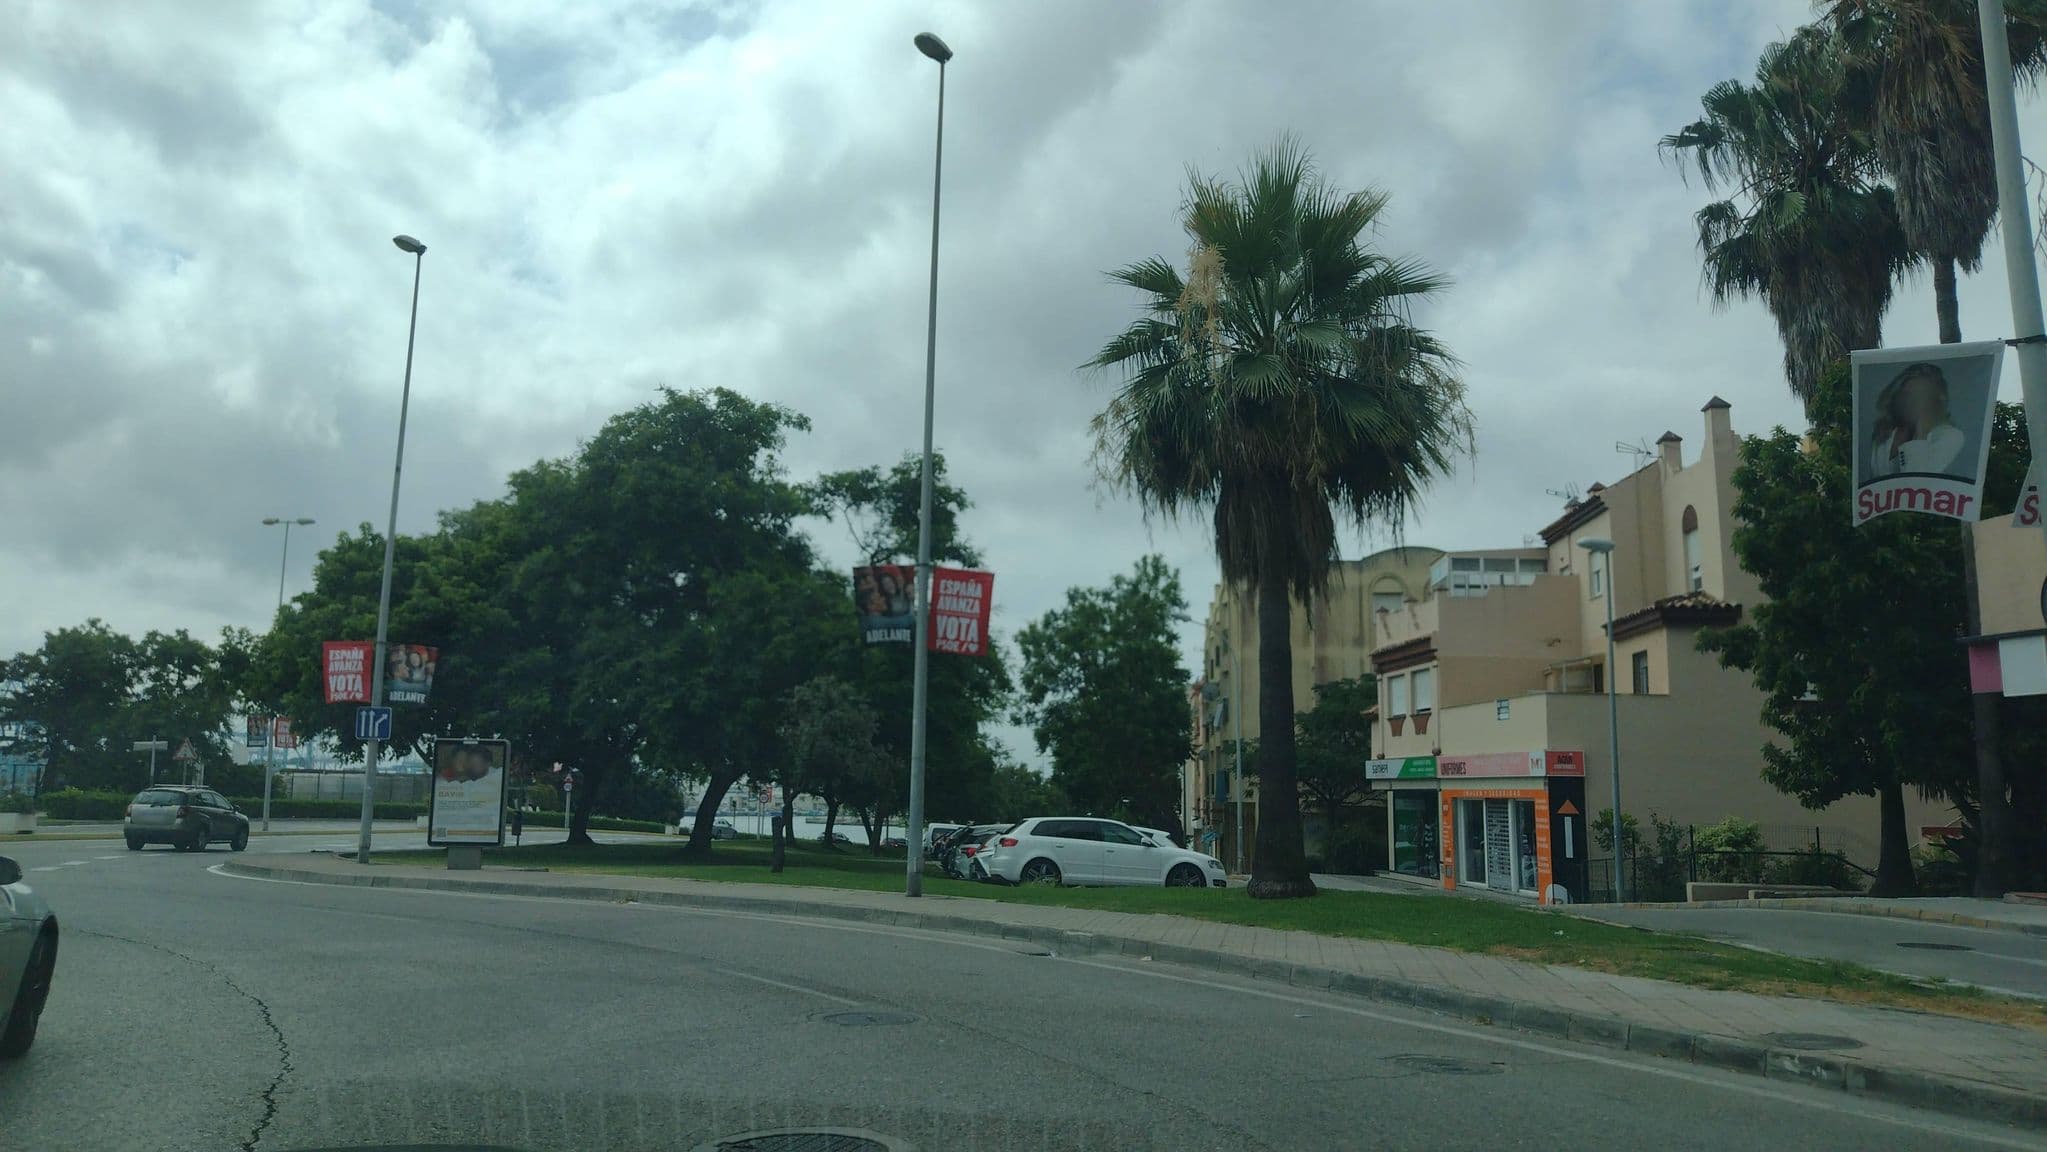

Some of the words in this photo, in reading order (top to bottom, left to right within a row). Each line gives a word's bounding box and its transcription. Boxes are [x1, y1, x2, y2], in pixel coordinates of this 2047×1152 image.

[1858, 487, 1973, 520] Sumar
[941, 579, 982, 597] ESPAÑA
[938, 597, 981, 613] AVANZA
[866, 628, 911, 643] ADELANTE
[936, 615, 979, 642] VOTA
[329, 648, 364, 660] ESPAÑA
[329, 660, 363, 673] AVANZA
[329, 674, 363, 692] VOTA
[389, 691, 426, 703] ADELANTE
